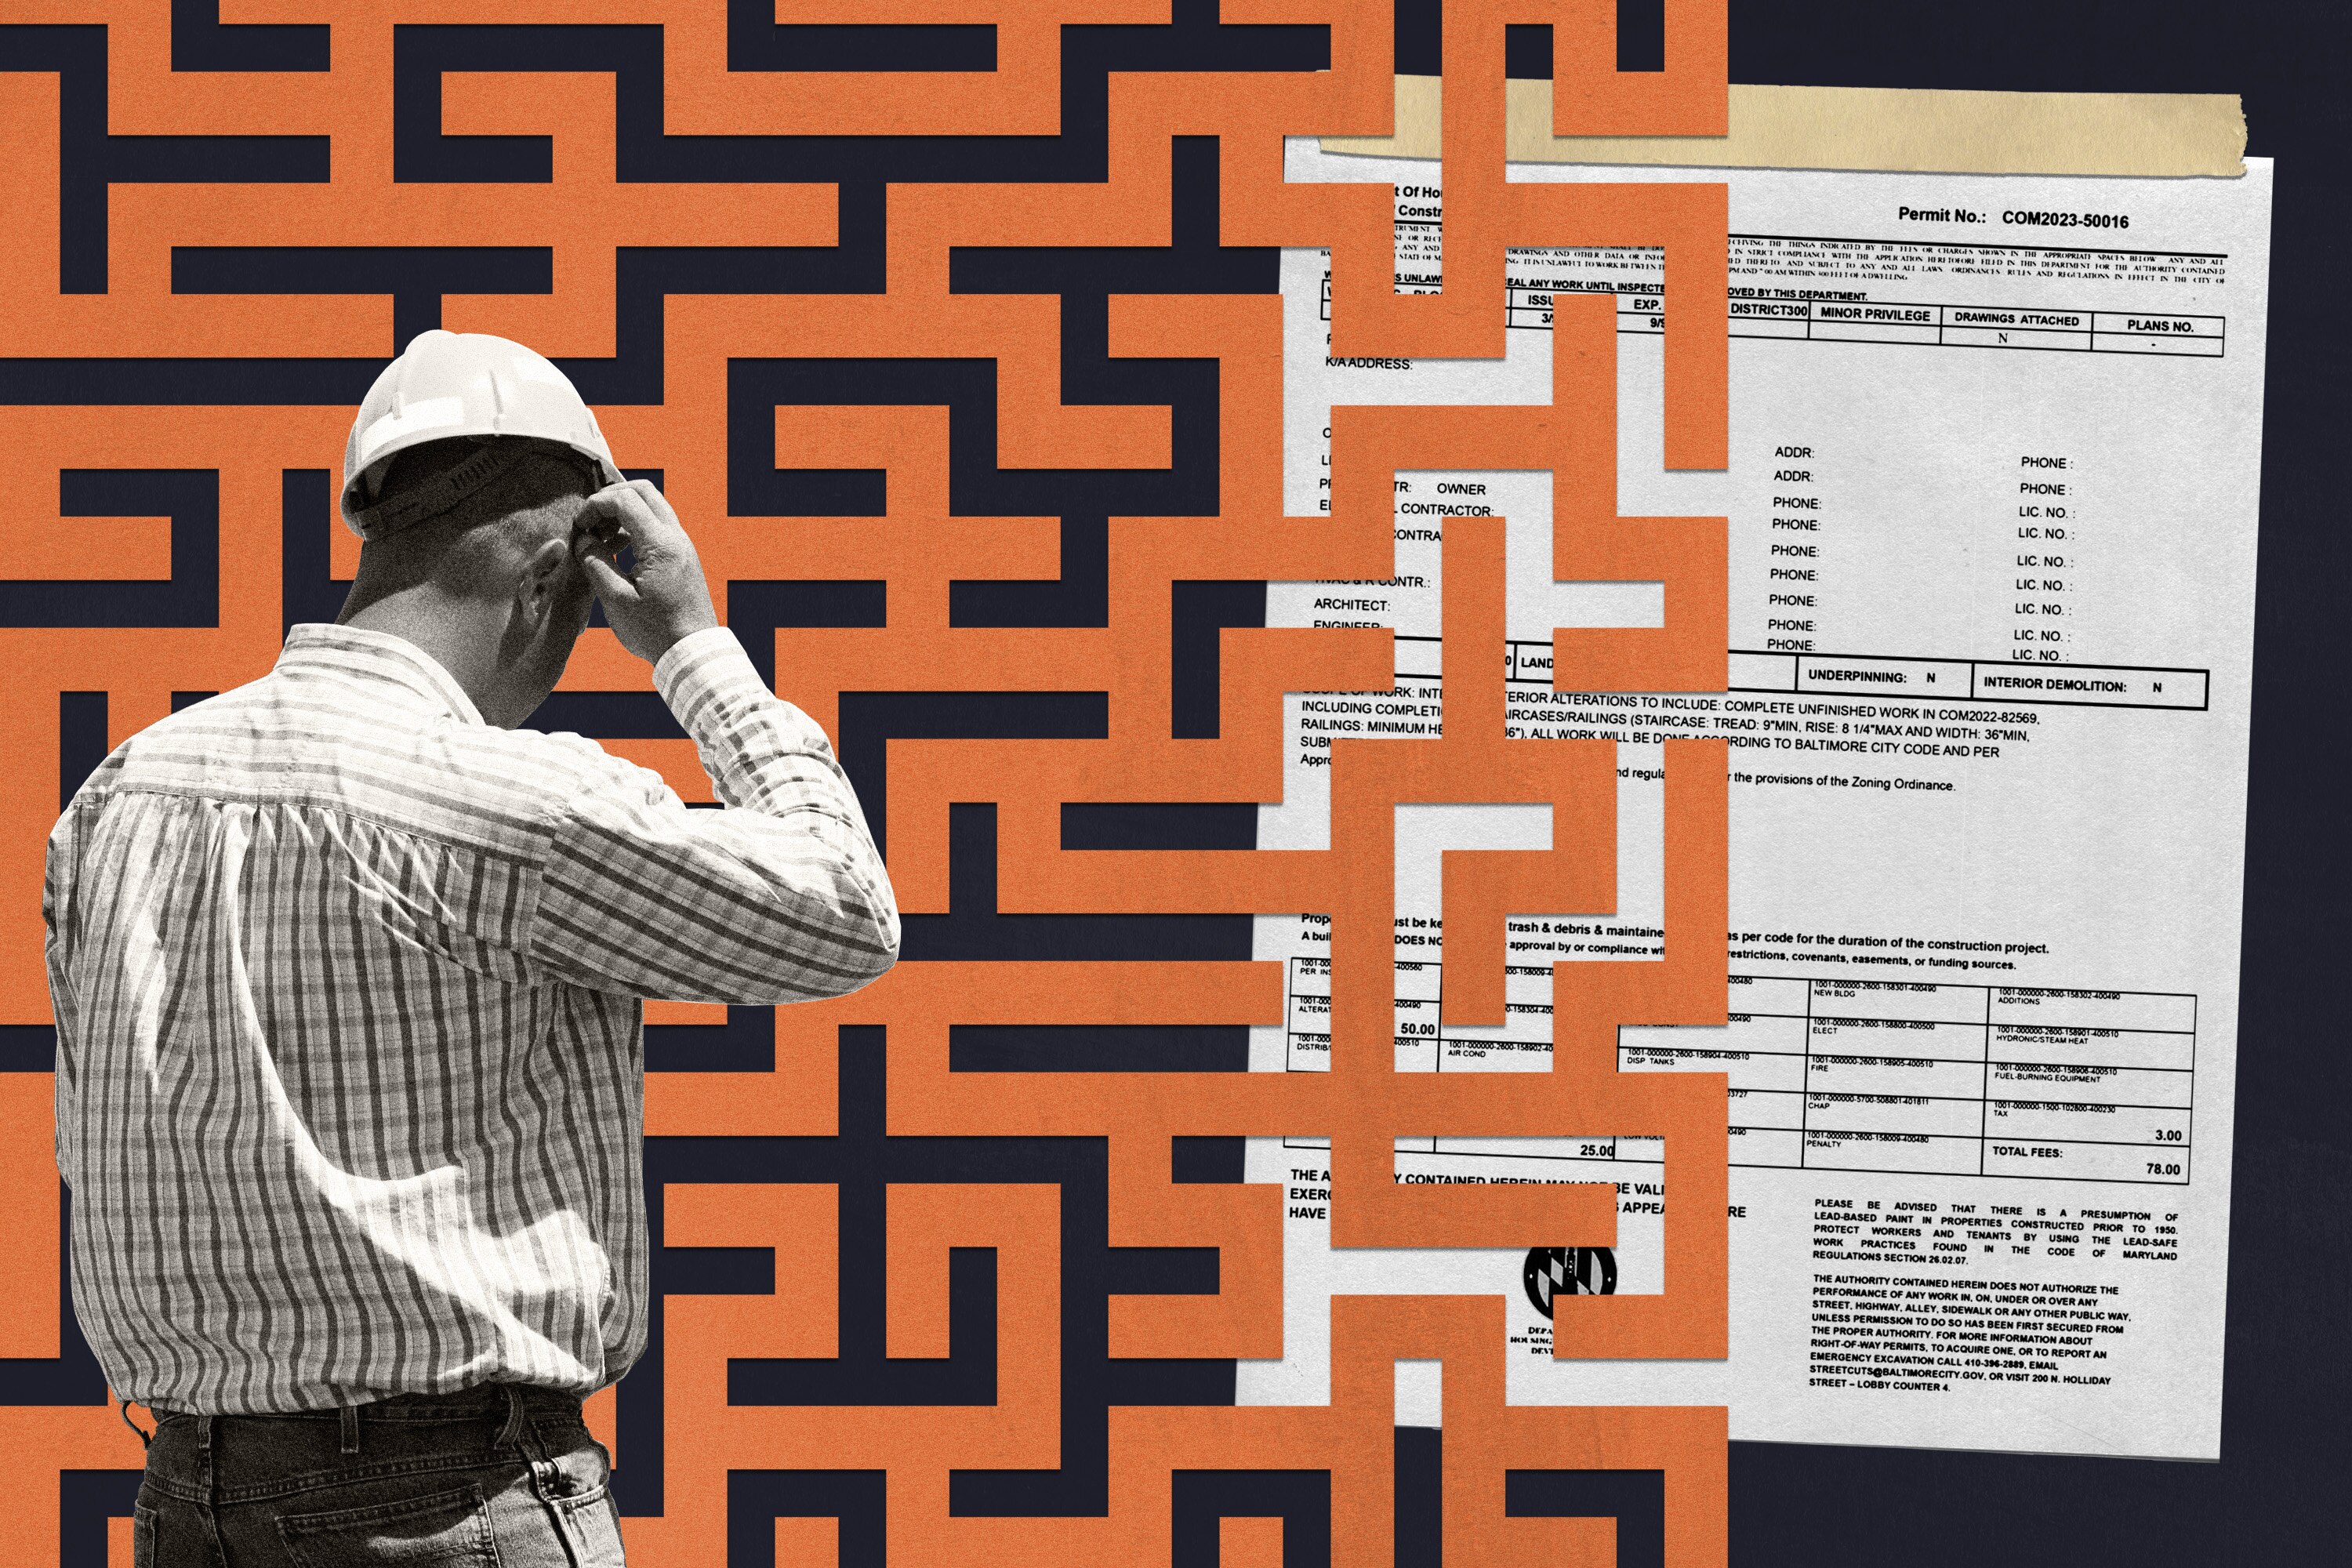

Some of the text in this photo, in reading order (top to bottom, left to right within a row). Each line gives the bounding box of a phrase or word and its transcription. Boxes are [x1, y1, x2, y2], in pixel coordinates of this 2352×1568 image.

[1403, 186, 1420, 197] Of
[1898, 206, 2129, 229] Permit No.: COM2023-50016
[1528, 278, 1616, 291] ANY WORK UNTIL
[1757, 288, 1868, 301] BY THIS DEPARTMENT.
[1633, 299, 1662, 310] EXP.
[1730, 303, 1807, 317] DISTRICT300
[1820, 307, 1931, 321] MINOR PRIVILEGE
[1955, 312, 2080, 326] DRAWINGS ATTACHED
[2127, 319, 2194, 332] PLANS NO.
[1998, 332, 2009, 343] N
[1348, 358, 1414, 370] ADDRESS:
[1774, 446, 1815, 459] ADDR:
[2021, 456, 2067, 470] PHONE
[1773, 470, 1814, 482] ADDR:
[1436, 482, 1486, 495] OWNER
[1773, 496, 1822, 509] PHONE:
[1400, 503, 1494, 517] CONTRACTOR:
[2019, 506, 2043, 517] LIC.
[2045, 507, 2068, 519] NO.
[1772, 518, 1821, 531] PHONE:
[2018, 527, 2042, 539] LIC.
[2045, 528, 2067, 540] NO.
[1771, 544, 1820, 557] PHONE:
[1769, 568, 1819, 581] PHONE:
[1313, 597, 1391, 612] ARCHITECT:
[1769, 593, 1818, 607] PHONE:
[1768, 619, 1817, 632] PHONE:
[1767, 638, 1816, 652] PHONE:
[1808, 669, 1936, 684] UNDERPINNING: N
[1984, 676, 2162, 693] INTERIOR DEMOLITION: N
[1301, 700, 1372, 714] INCLUDING
[1550, 692, 1638, 708] ALTERATIONS
[1640, 696, 1659, 708] TO
[1661, 698, 1721, 711] INCLUDE:
[1724, 700, 1795, 714] COMPLETE
[1798, 703, 1877, 717] UNFINISHED
[1878, 707, 1920, 719] WORK
[1922, 709, 1936, 720] IN
[1301, 718, 1425, 734] RAILINGS: MINIMUM
[1630, 714, 1709, 728] (STAIRCASE:
[1712, 717, 1759, 730] TREAD:
[1805, 721, 1838, 733] RISE:
[1842, 723, 1849, 734] 8
[1904, 725, 1933, 737] AND
[1935, 727, 1981, 739] WIDTH:
[1530, 728, 1650, 743] ALL WORK WILL BE
[1773, 738, 2000, 758] TO BALTIMORE CITY CODE AND PER
[1733, 771, 1956, 791] the provisions of the Zoning Ordinance.
[1508, 921, 1603, 935] trash & debris &
[1508, 941, 1555, 952] approval
[1558, 942, 1572, 953] by
[1587, 944, 1649, 955] compliance
[1741, 933, 1762, 943] per
[1764, 933, 1794, 943] code
[1796, 933, 1814, 944] for
[1816, 934, 1835, 945] the
[1838, 935, 1888, 947] duration
[1889, 937, 1904, 948] of
[1905, 938, 1925, 949] the
[1927, 940, 2002, 952] construction
[2004, 942, 2049, 955] project.
[1791, 953, 1849, 964] covenants,
[1851, 956, 1912, 967] easements,
[1928, 956, 1969, 970] funding
[1971, 960, 2016, 970] sources.
[1998, 996, 2041, 1005] ADDITIONS
[1400, 1022, 1436, 1035] 50.00
[1462, 1050, 1486, 1058] COND
[1810, 1064, 1828, 1073] FIRE
[1994, 1072, 2101, 1083] FUEL-BURNING EQUIPMENT
[2155, 1129, 2183, 1142] 3.00
[1580, 1145, 1615, 1156] 25.00
[1992, 1146, 2063, 1158] TOTAL FEES:
[1290, 1169, 1319, 1181] THE
[2146, 1163, 2181, 1175] 78.00
[1289, 1207, 1327, 1219] HAVE
[1814, 1198, 2179, 1221] PLEASE BE ADVISED THAT THERE IS A PRESUMPTION OF
[1812, 1250, 1969, 1265] REGULATIONS SECTION 26.02.07.
[1809, 1352, 1872, 1363] EMERGENCY
[1873, 1354, 1935, 1365] EXCAVATION
[1936, 1357, 1963, 1367] CALL
[2028, 1361, 2059, 1370] EMAIL
[1809, 1377, 1848, 1388] STREET
[1857, 1380, 1891, 1389] LOBBY
[1893, 1381, 1940, 1392] COUNTER
[1988, 1372, 2004, 1381] OR
[2005, 1373, 2031, 1381] VISIT
[2031, 1374, 2049, 1382] 200
[2063, 1375, 2111, 1385] HOLLIDAY
